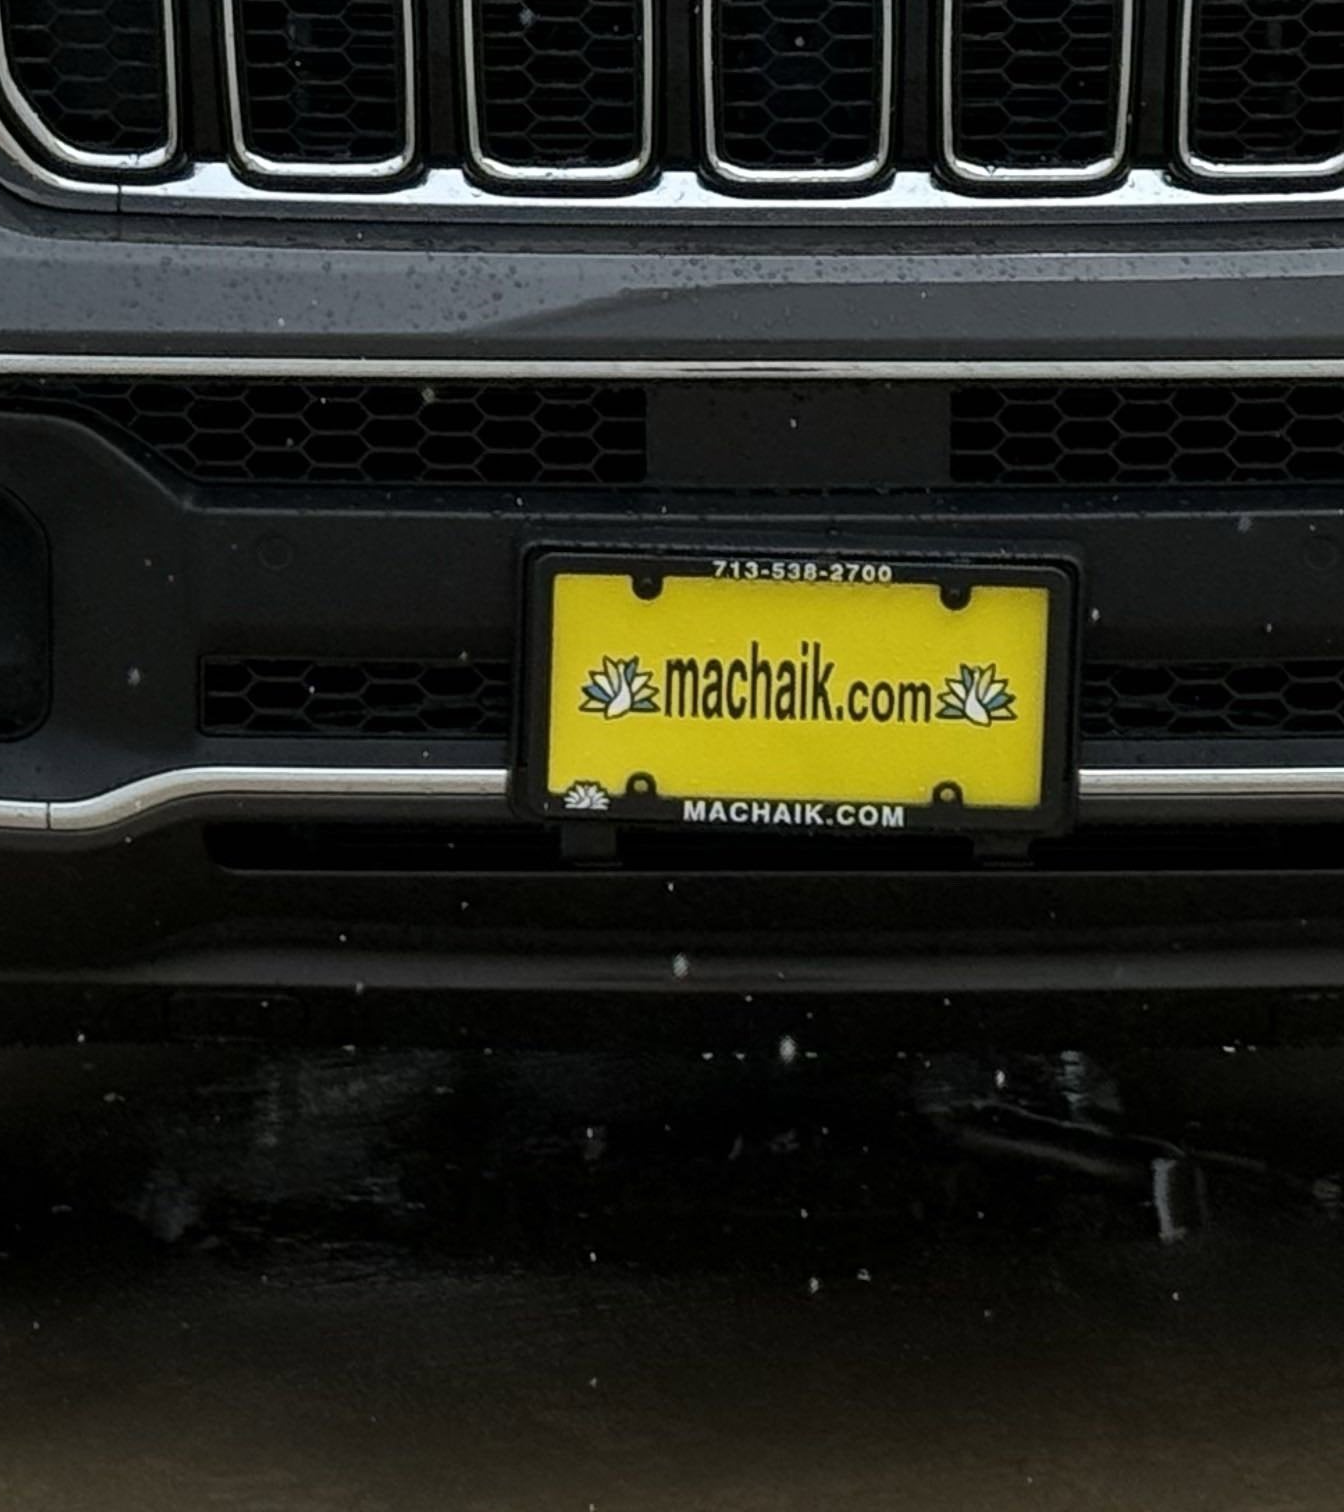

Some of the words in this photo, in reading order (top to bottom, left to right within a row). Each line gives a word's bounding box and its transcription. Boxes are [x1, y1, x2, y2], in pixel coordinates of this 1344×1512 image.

[712, 560, 892, 583] 713-538-2700
[663, 640, 931, 723] machaik.com
[683, 799, 905, 828] MACHAIK.COM
